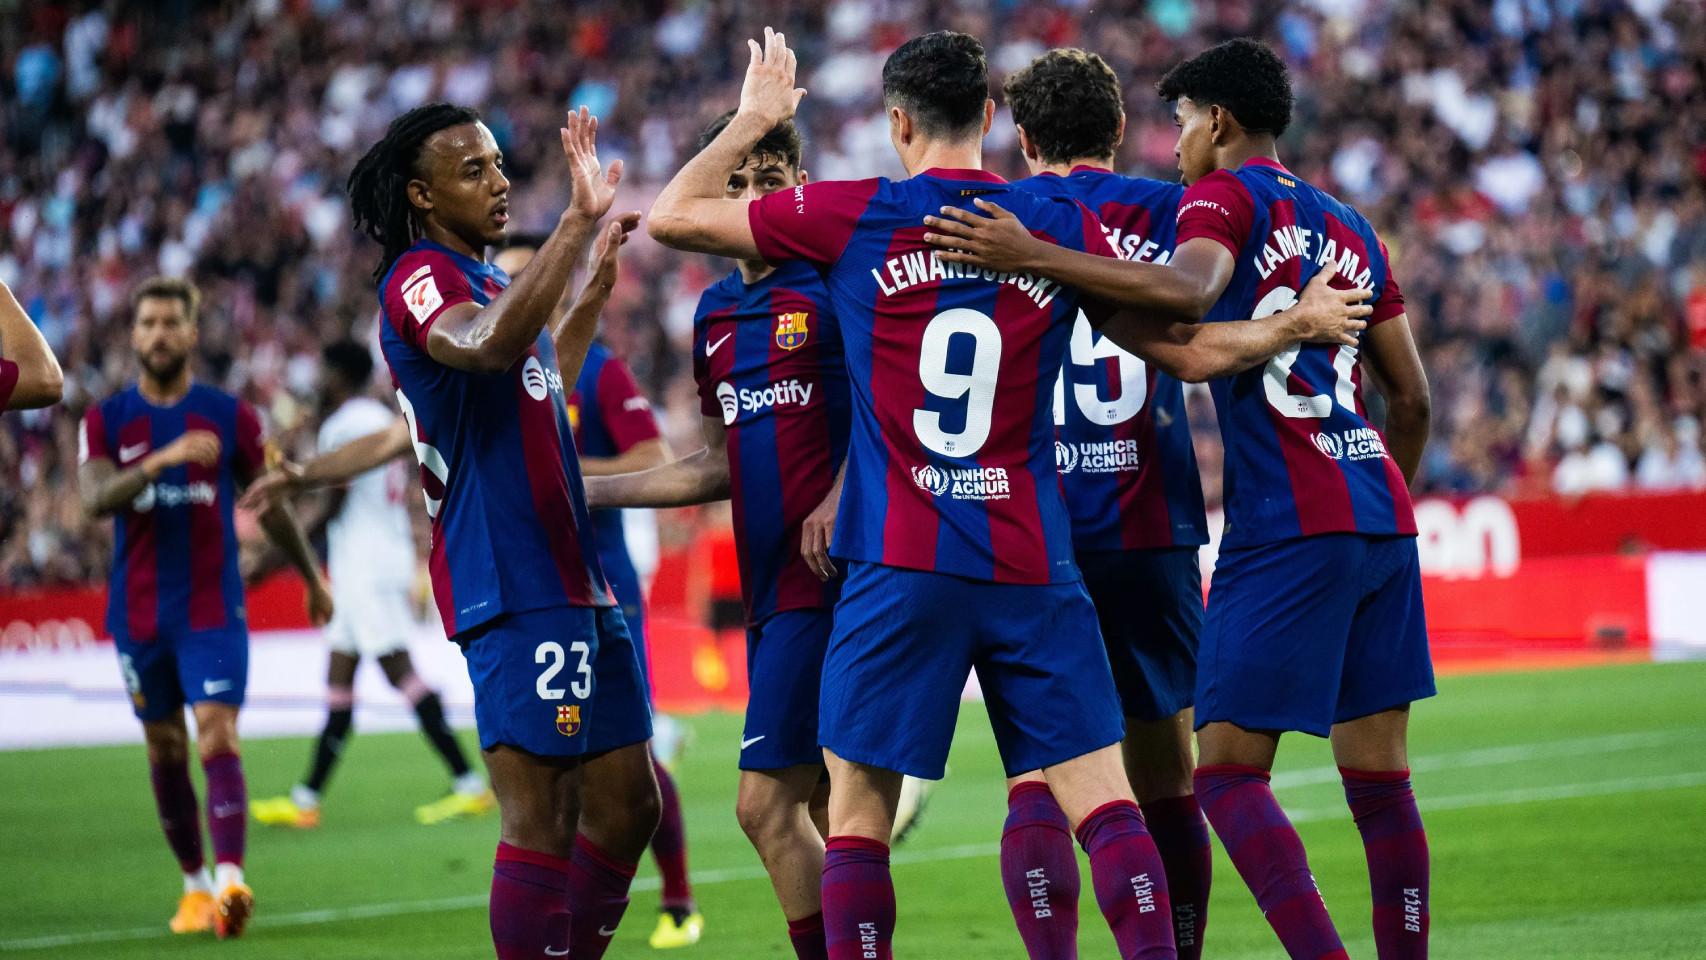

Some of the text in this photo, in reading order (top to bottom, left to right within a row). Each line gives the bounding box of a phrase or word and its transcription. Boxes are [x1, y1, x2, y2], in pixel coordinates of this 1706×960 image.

[870, 248, 1063, 310] LEWANDSKI
[739, 379, 813, 413] Spotify
[912, 307, 1003, 458] 9
[1080, 440, 1138, 455] UNHCR
[1081, 453, 1139, 467] ACNUR
[951, 468, 1008, 481] UNHCR
[951, 481, 1010, 494] ACNUR
[534, 641, 592, 700] 23
[1026, 867, 1053, 919] BARÇA
[1130, 872, 1156, 914] BARÇA
[1403, 887, 1422, 933] BARÇA
[858, 922, 879, 959] BARÇA
